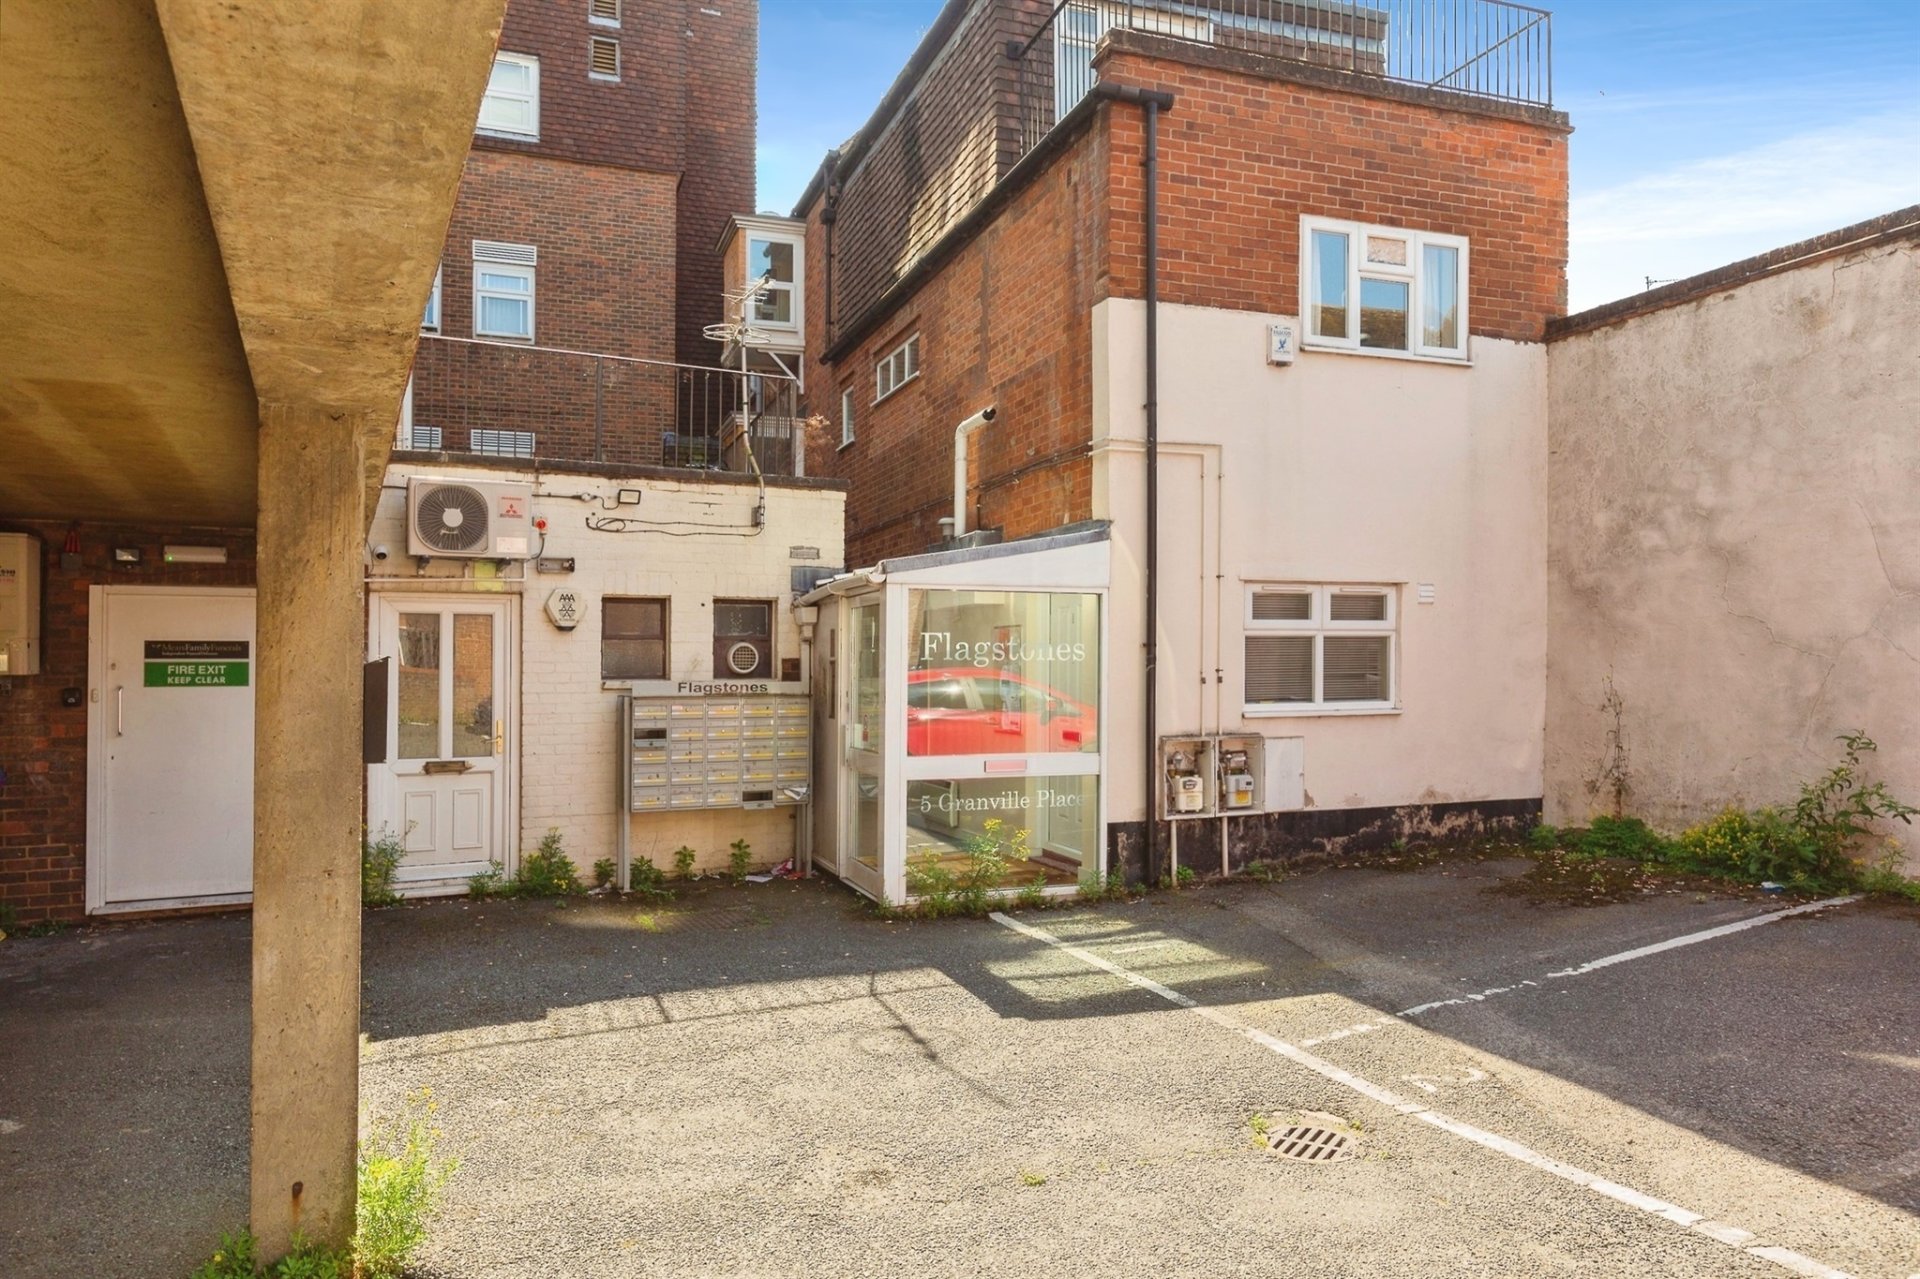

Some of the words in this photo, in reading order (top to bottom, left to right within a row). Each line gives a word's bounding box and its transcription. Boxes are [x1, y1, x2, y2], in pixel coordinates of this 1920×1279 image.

[920, 632, 1086, 668] Flagstones
[167, 665, 196, 674] FIRE
[198, 665, 227, 674] EXIT
[167, 676, 191, 684] KEEP
[195, 676, 226, 684] CLEAR
[678, 682, 768, 696] Flagstones
[920, 795, 932, 813] 5
[938, 791, 1031, 811] Granville
